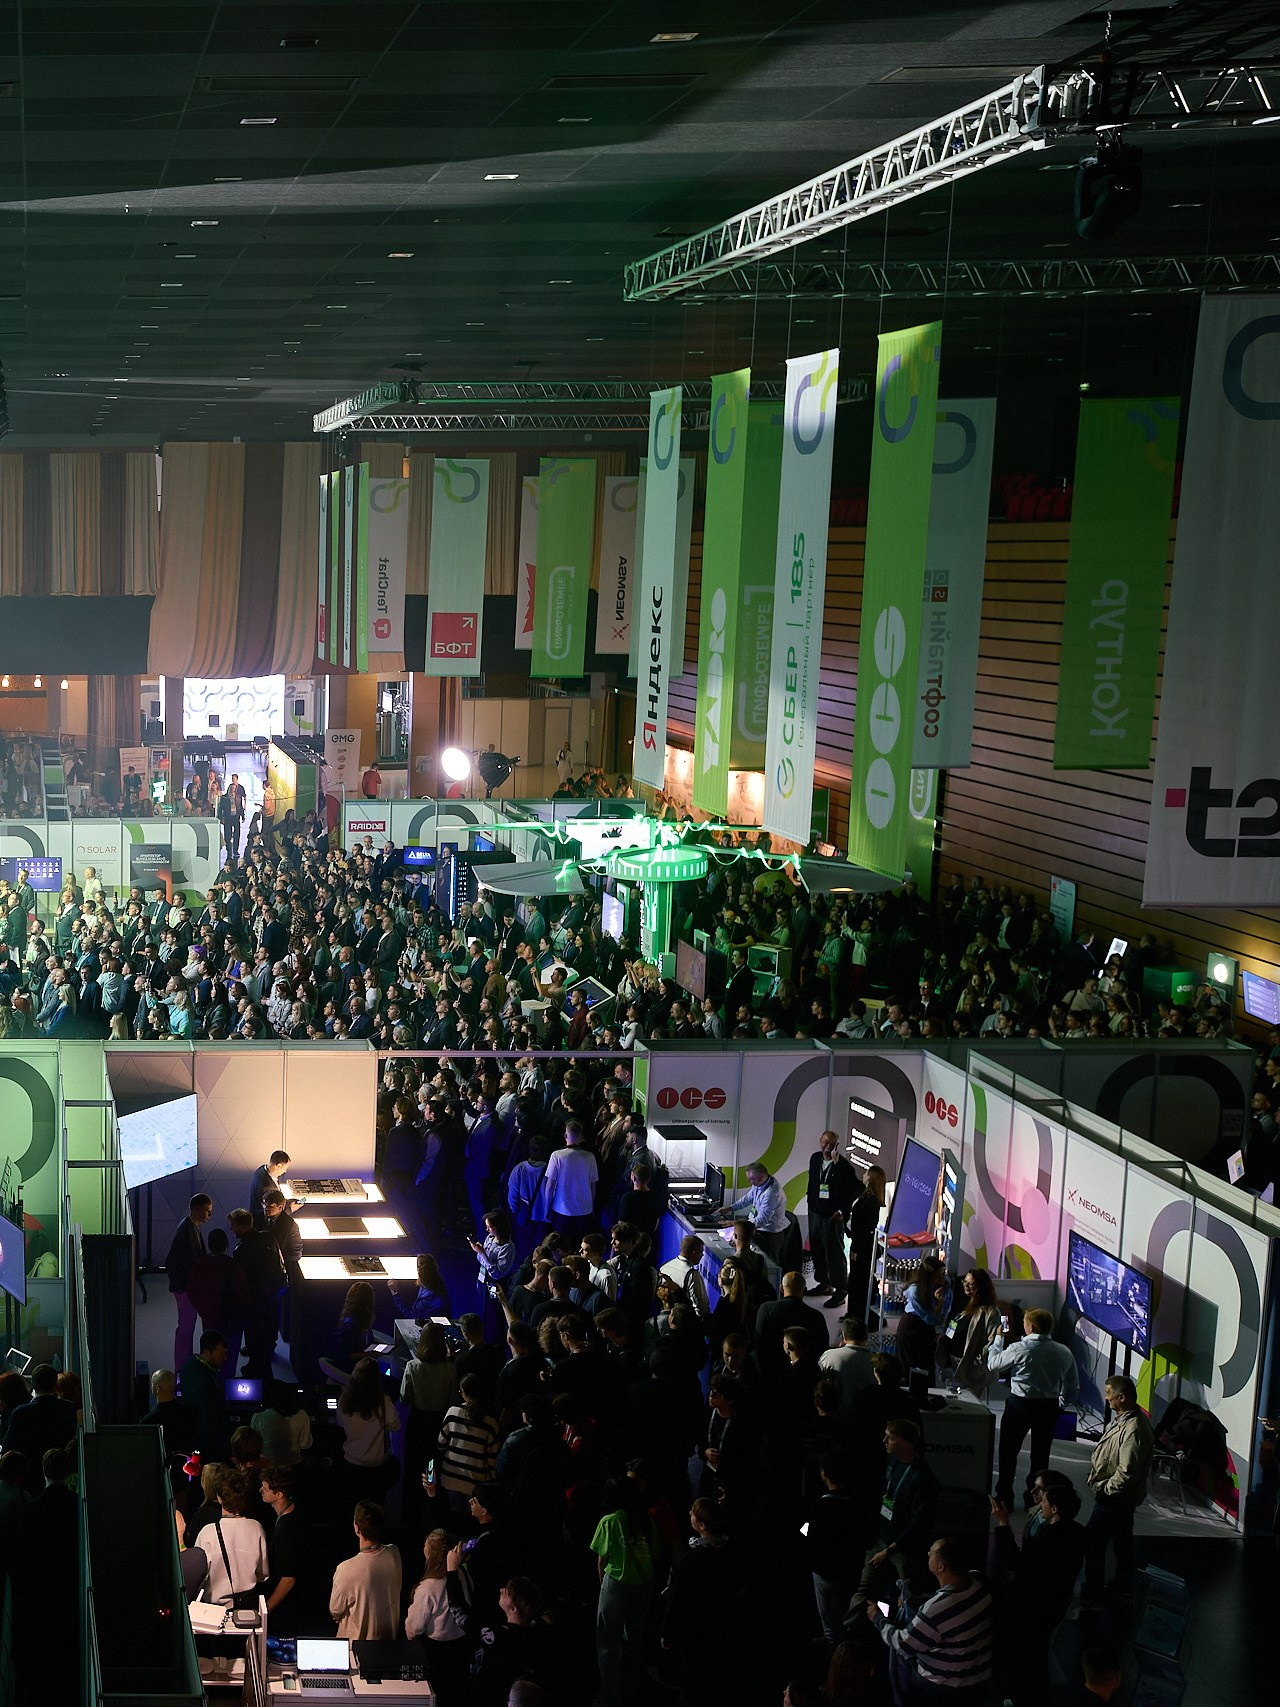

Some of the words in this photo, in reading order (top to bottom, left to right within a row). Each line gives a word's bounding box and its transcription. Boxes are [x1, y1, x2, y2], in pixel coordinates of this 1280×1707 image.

[434, 642, 472, 654] БФТ
[782, 646, 798, 746] СБЕР
[790, 532, 806, 604] 185
[642, 584, 664, 753] Яндекс
[703, 588, 727, 775] YADRO
[797, 635, 811, 749] Генеральный
[86, 846, 117, 854] SOLAR
[656, 1087, 727, 1109] OCS
[924, 1090, 959, 1128] OCS
[1078, 1197, 1117, 1227] NEOMSA
